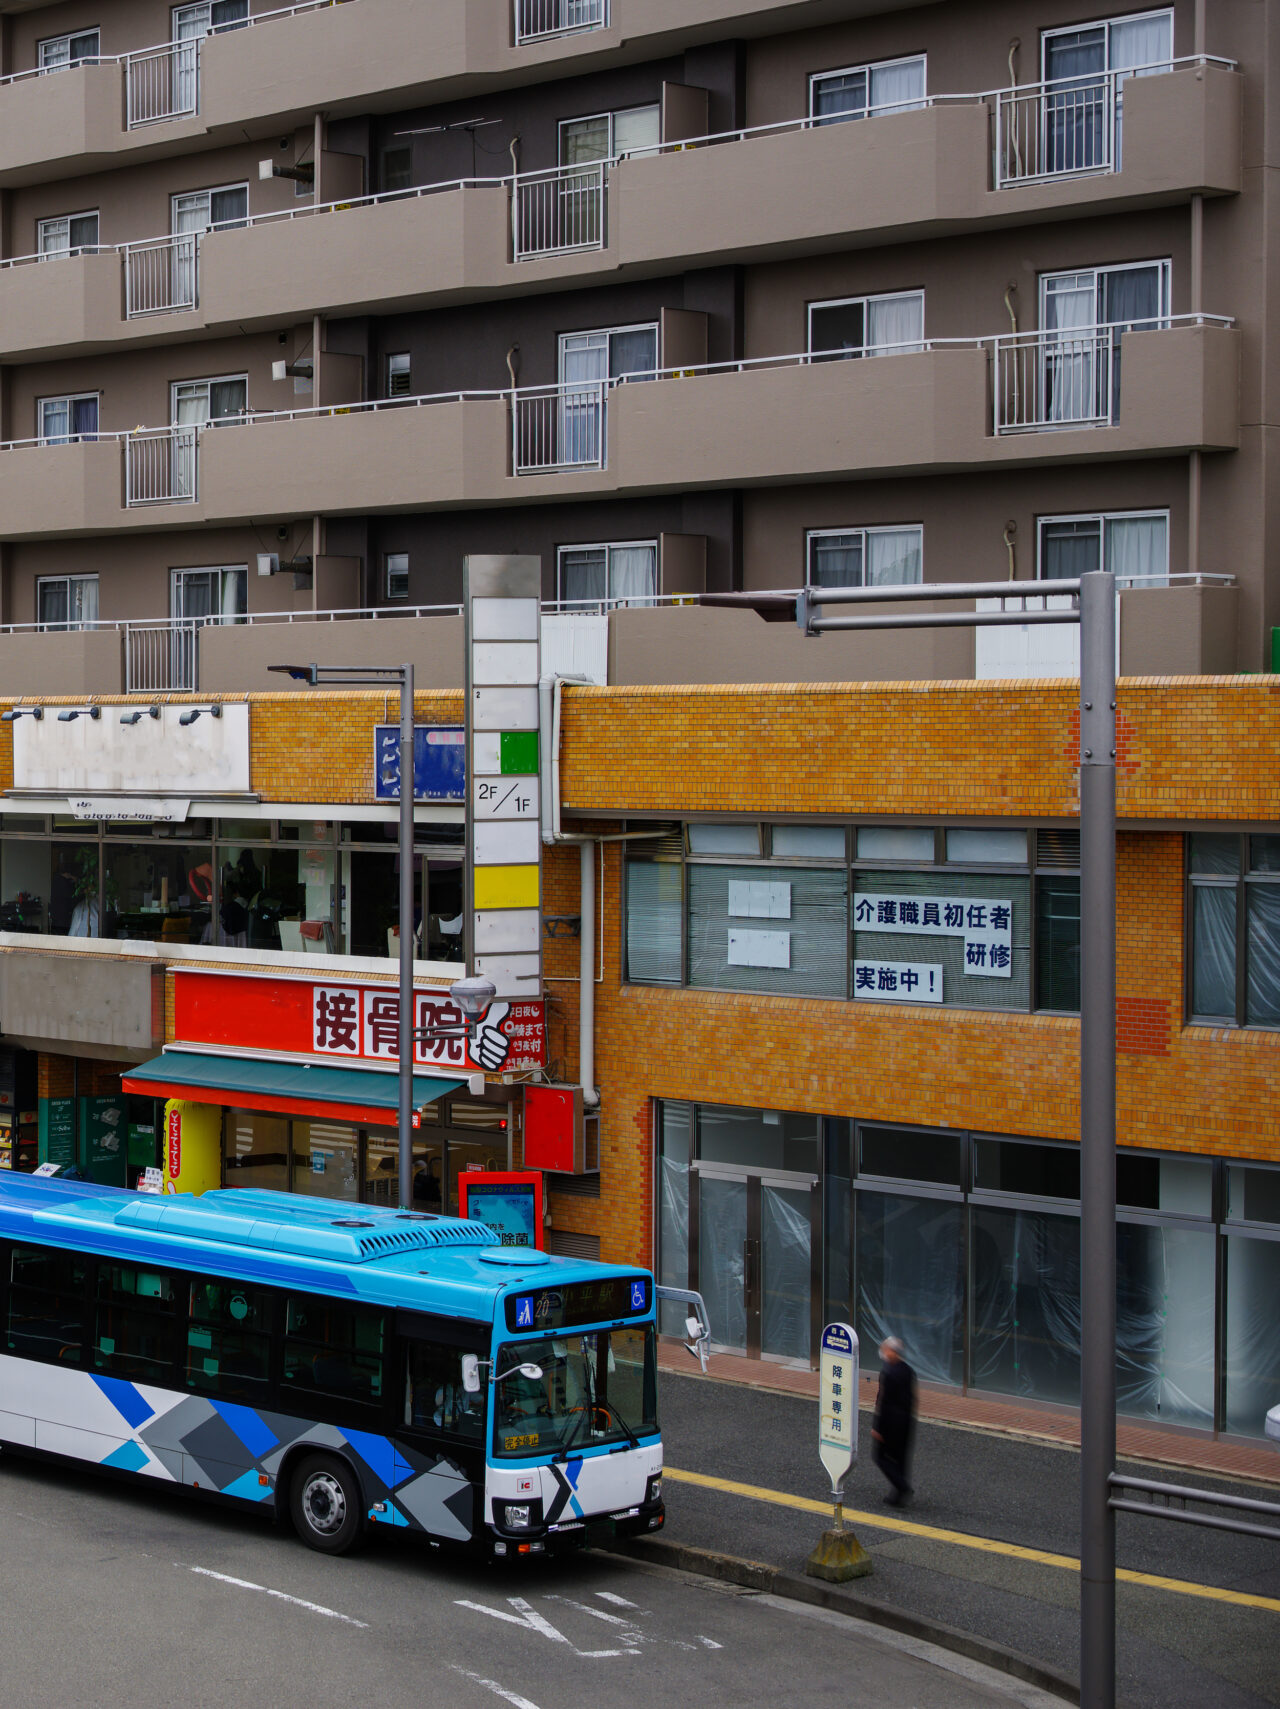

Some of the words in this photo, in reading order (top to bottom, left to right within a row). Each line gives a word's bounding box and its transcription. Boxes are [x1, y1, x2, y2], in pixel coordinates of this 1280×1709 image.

[856, 899, 1010, 930] 介護職員初任者
[966, 942, 1010, 968] 研修
[855, 966, 935, 992] 実施中!
[316, 990, 462, 1061] 接骨院
[498, 1232, 529, 1246] 除菌
[831, 1364, 843, 1432] 降車専用
